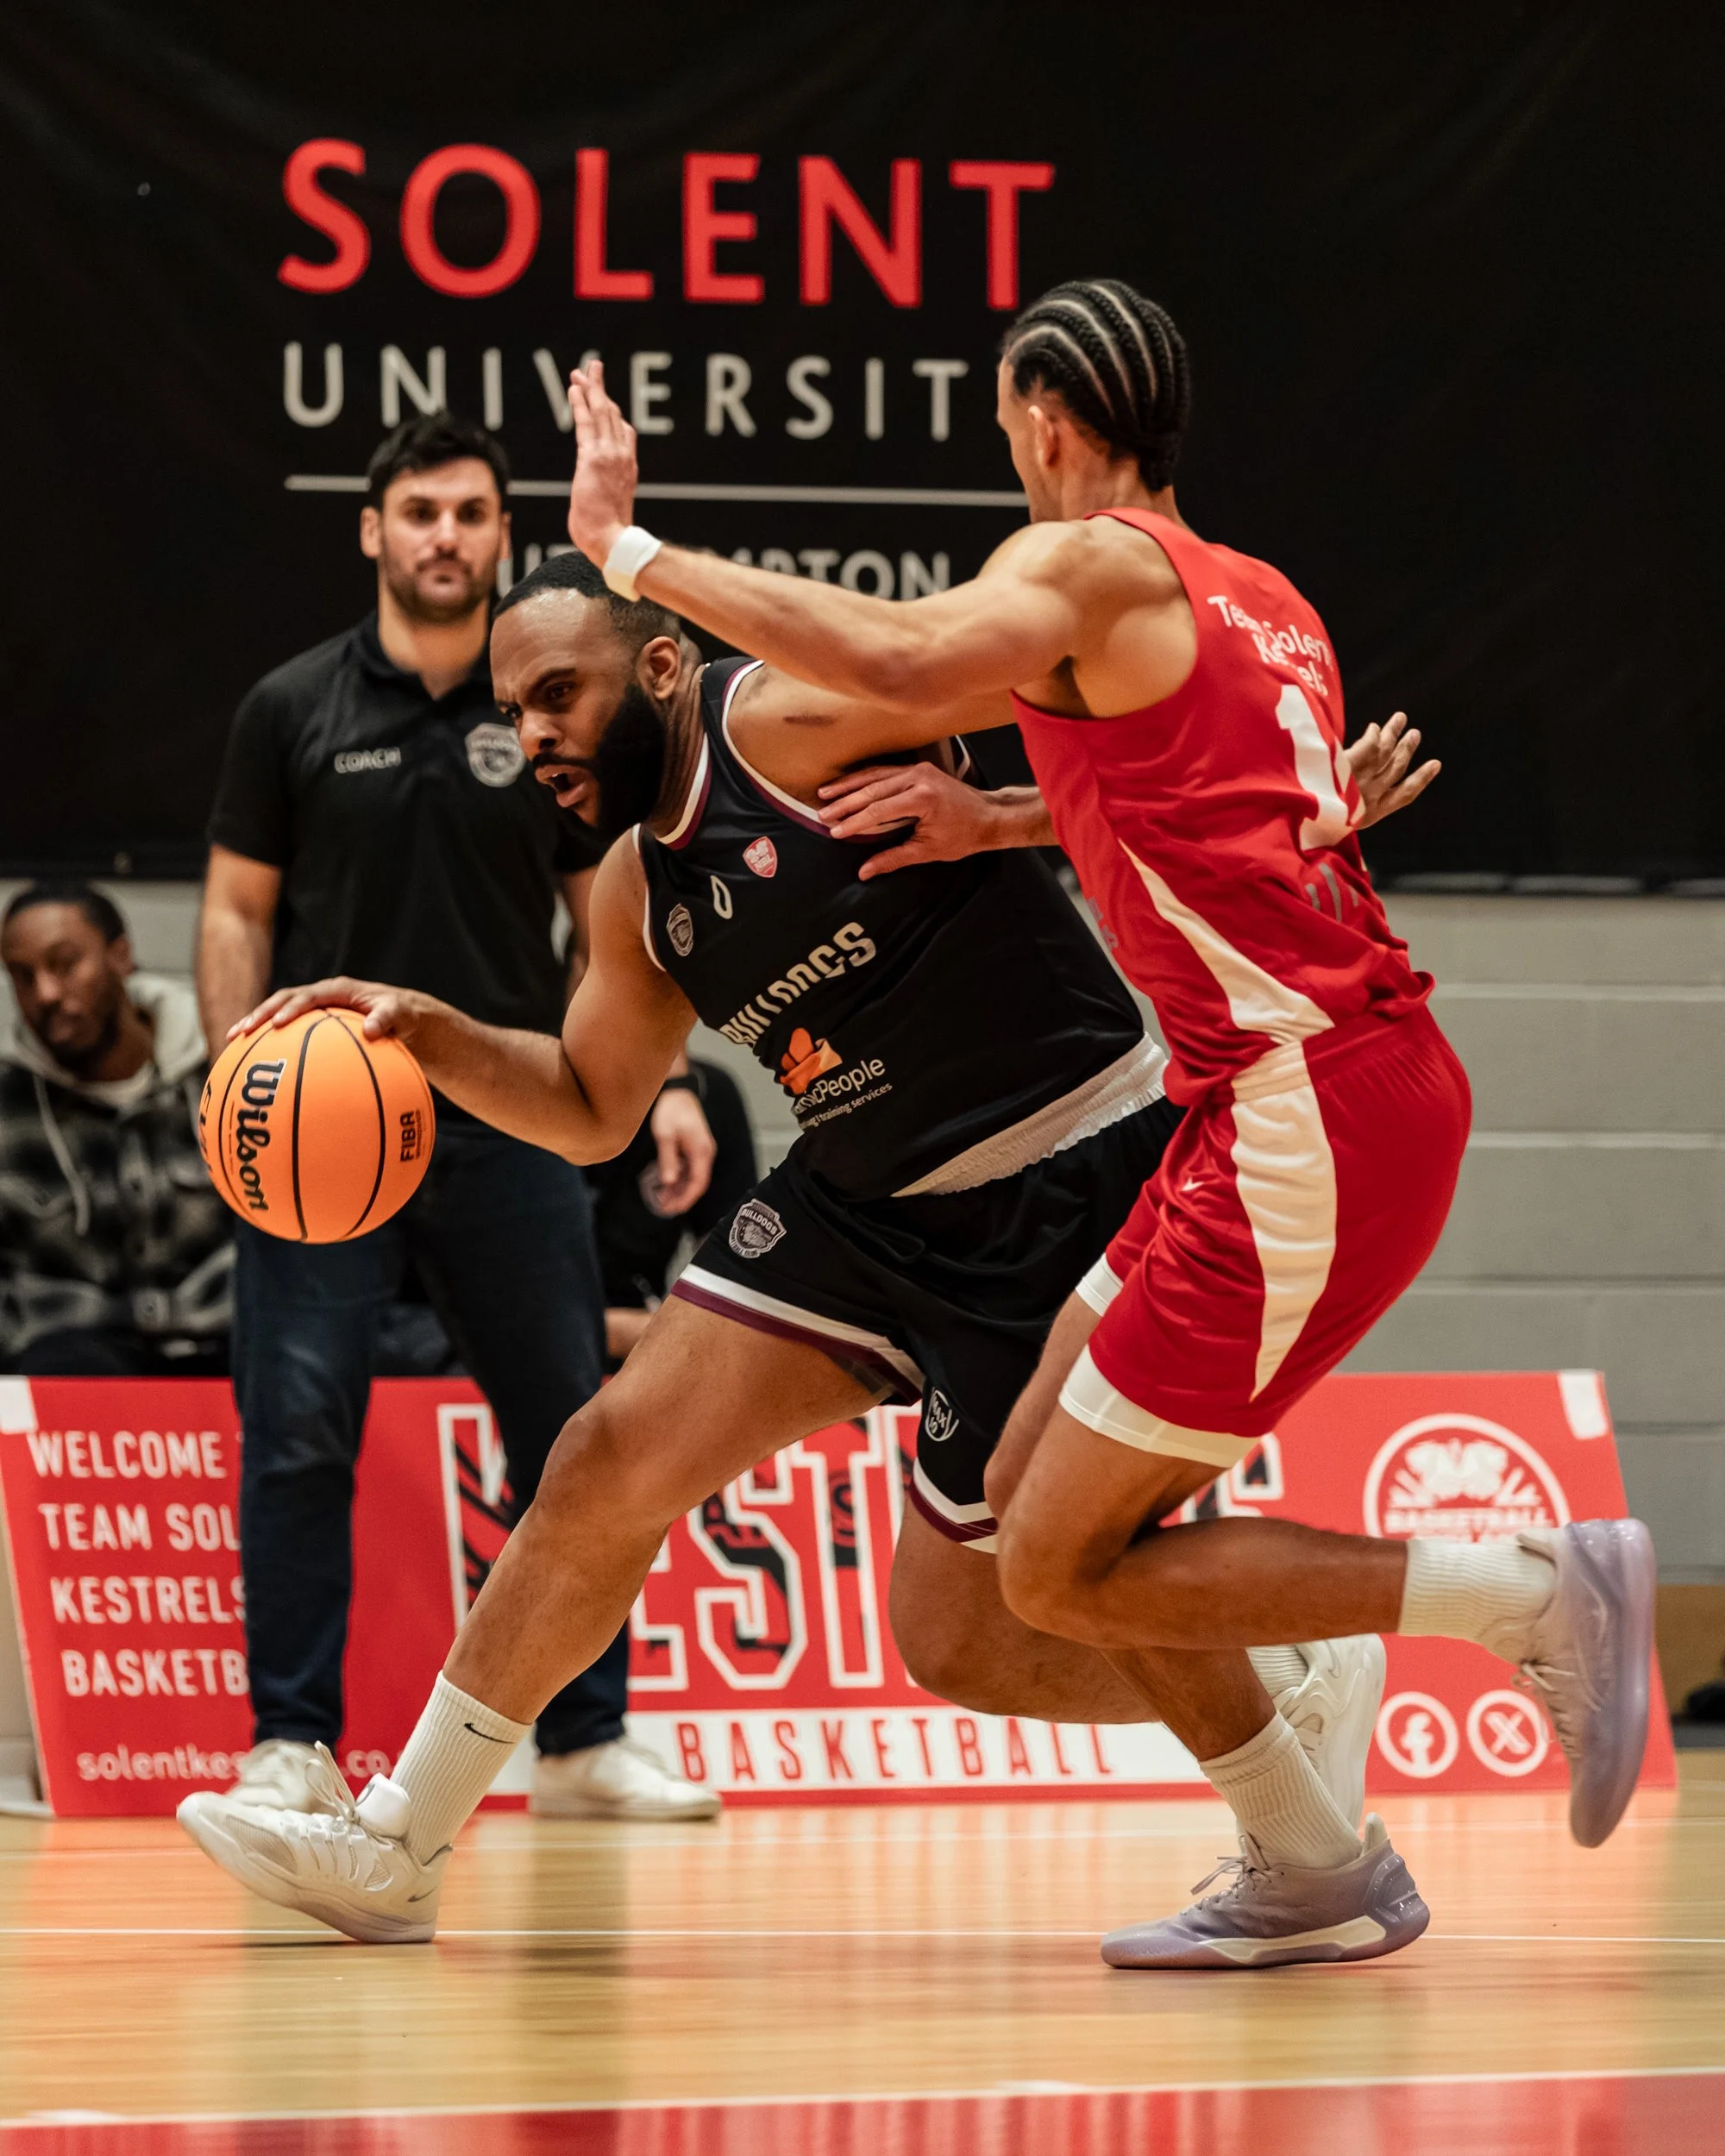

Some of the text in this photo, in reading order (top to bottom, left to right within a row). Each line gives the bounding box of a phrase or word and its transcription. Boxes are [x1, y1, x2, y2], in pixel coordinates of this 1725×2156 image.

[276, 137, 1056, 310] SOLENT
[283, 342, 969, 442] UNIVERSIT
[1262, 620, 1334, 672] Solen
[850, 1082, 894, 1108] services
[236, 1059, 287, 1212] Wilson
[399, 1110, 417, 1163] FIBA
[28, 1430, 227, 1479] WELCOME
[38, 1502, 242, 1551] TEAM SOL
[60, 1648, 250, 1697] BASKETB
[675, 1717, 1113, 1783] BASKETBALL
